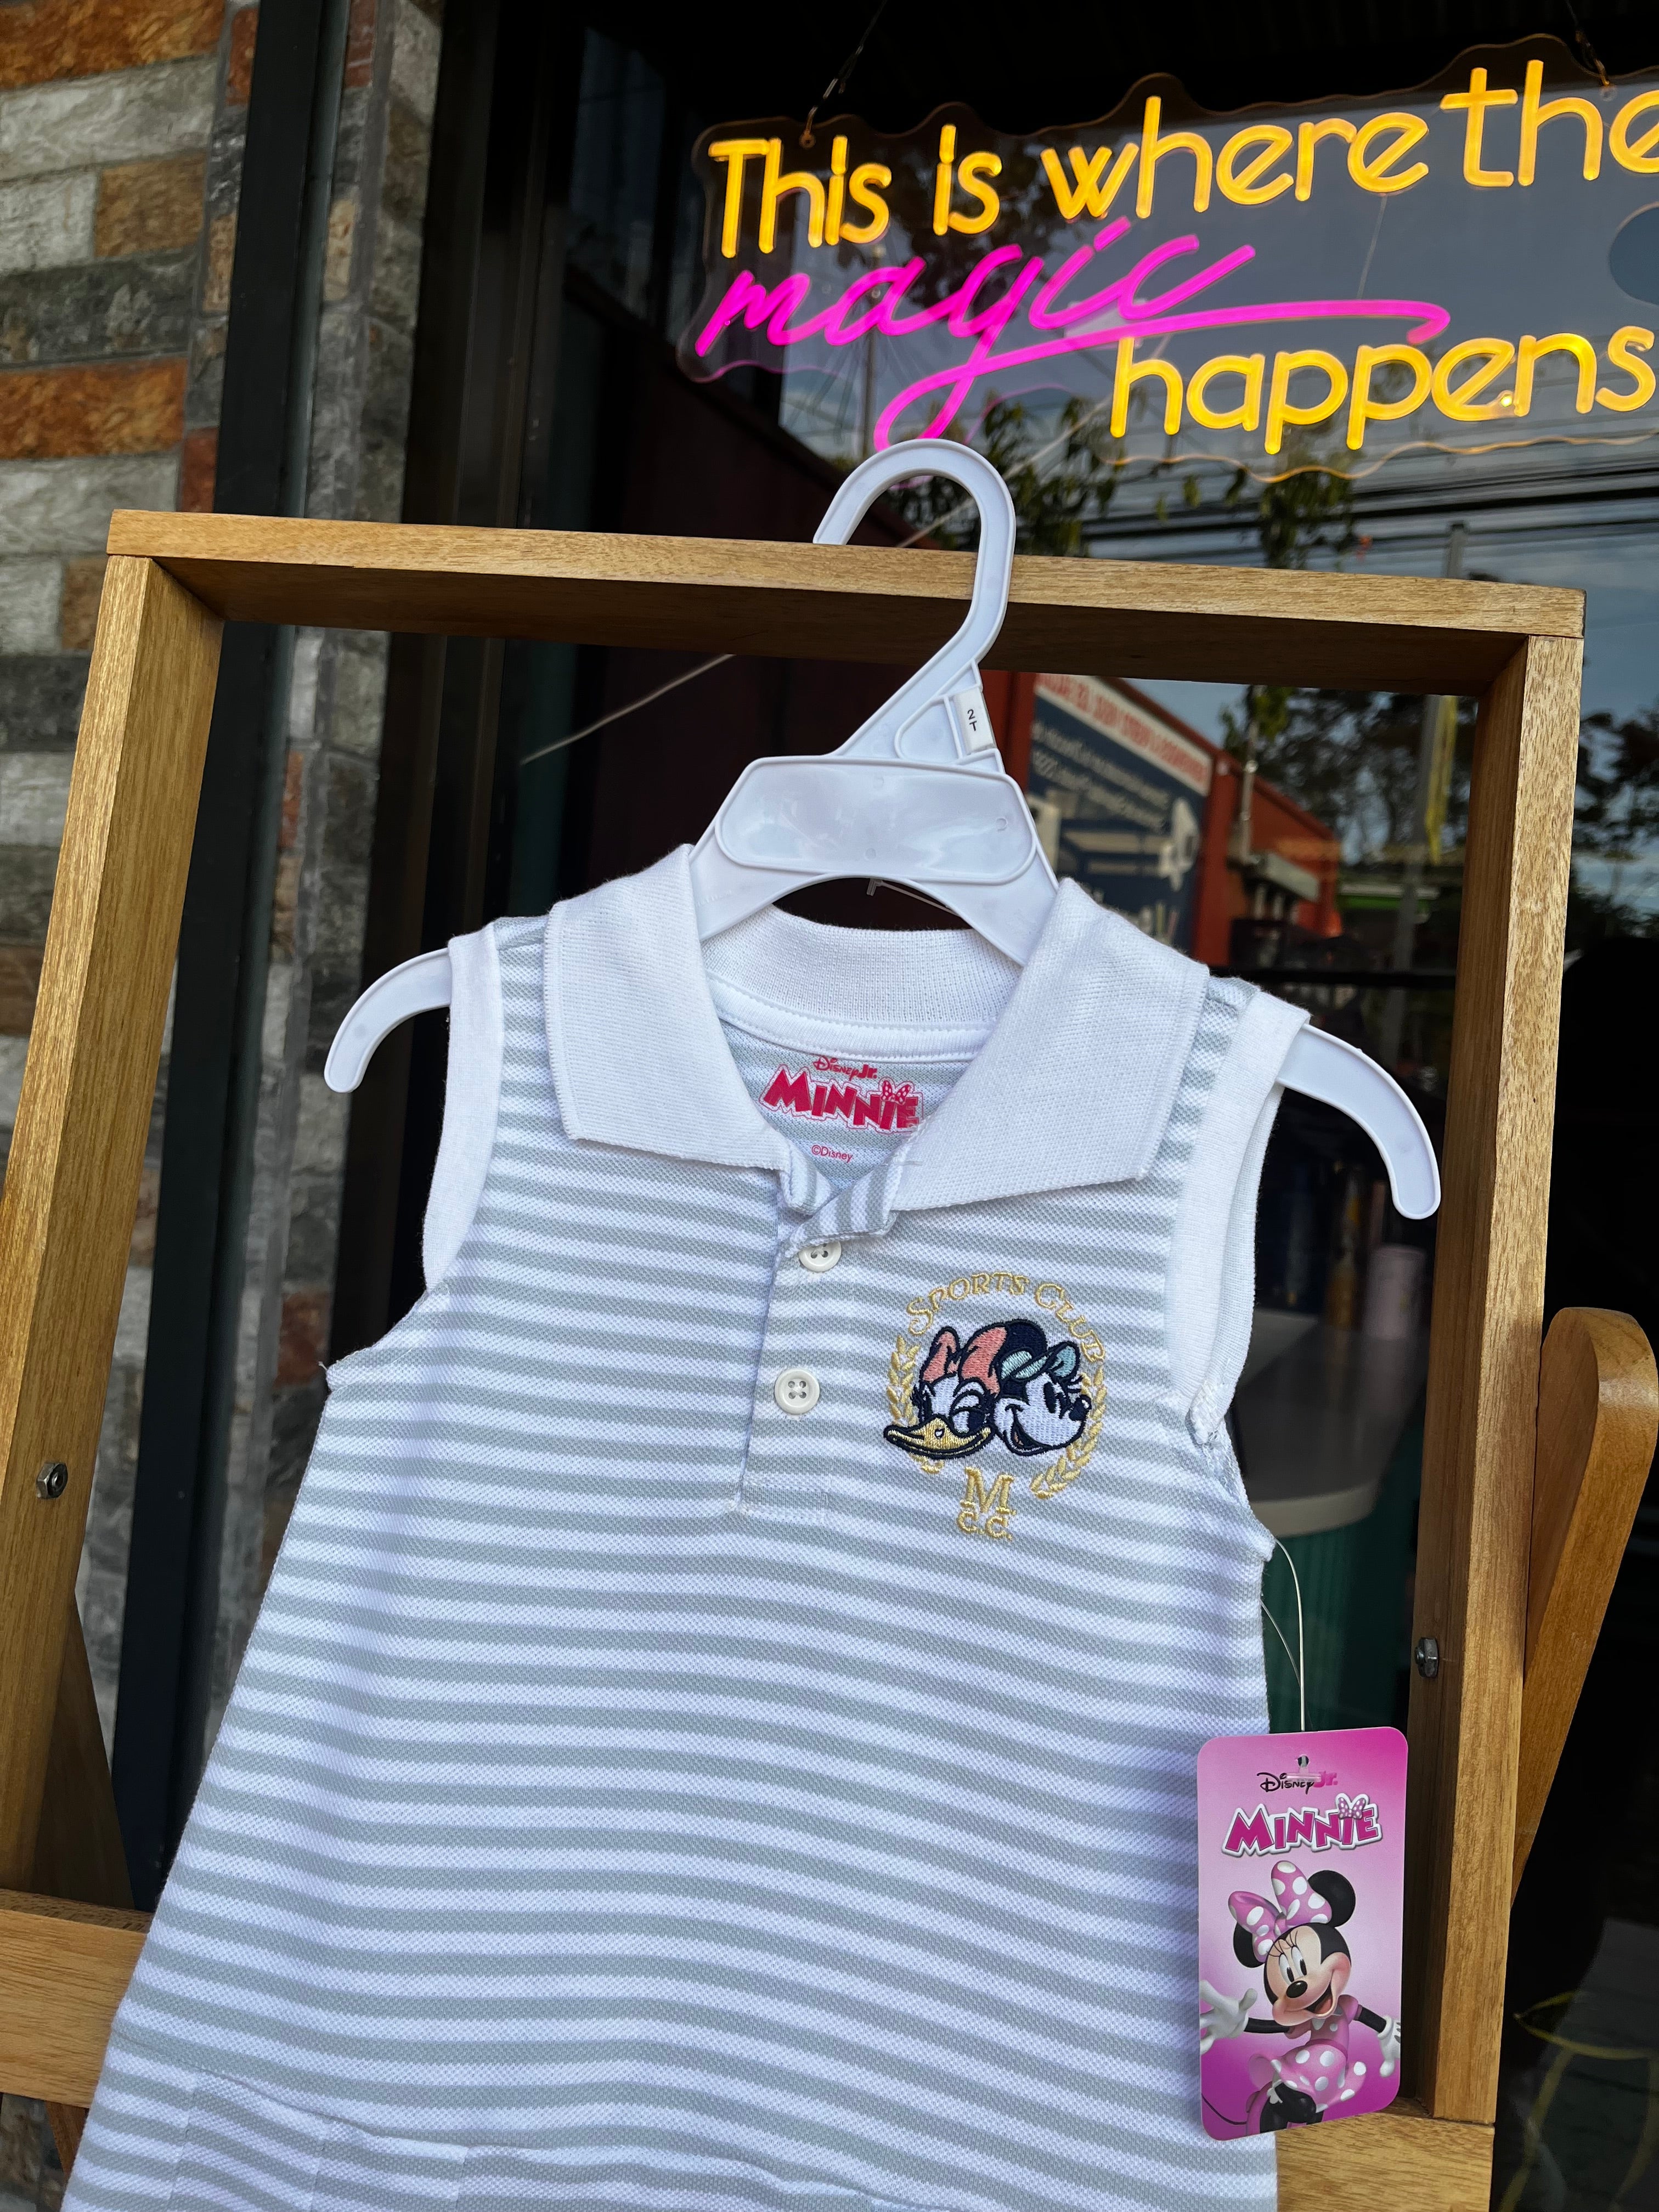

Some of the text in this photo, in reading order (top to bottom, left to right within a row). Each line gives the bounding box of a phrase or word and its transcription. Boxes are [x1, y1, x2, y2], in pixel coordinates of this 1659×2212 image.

[708, 137, 893, 258] This
[933, 124, 1003, 236] is
[1040, 94, 1429, 219] where
[695, 216, 1451, 452] magic
[1110, 325, 1656, 455] happens
[761, 1067, 922, 1131] MINNIE
[906, 1271, 1106, 1363] SPORTS CLUB
[1224, 1807, 1379, 1853] MINNIE
